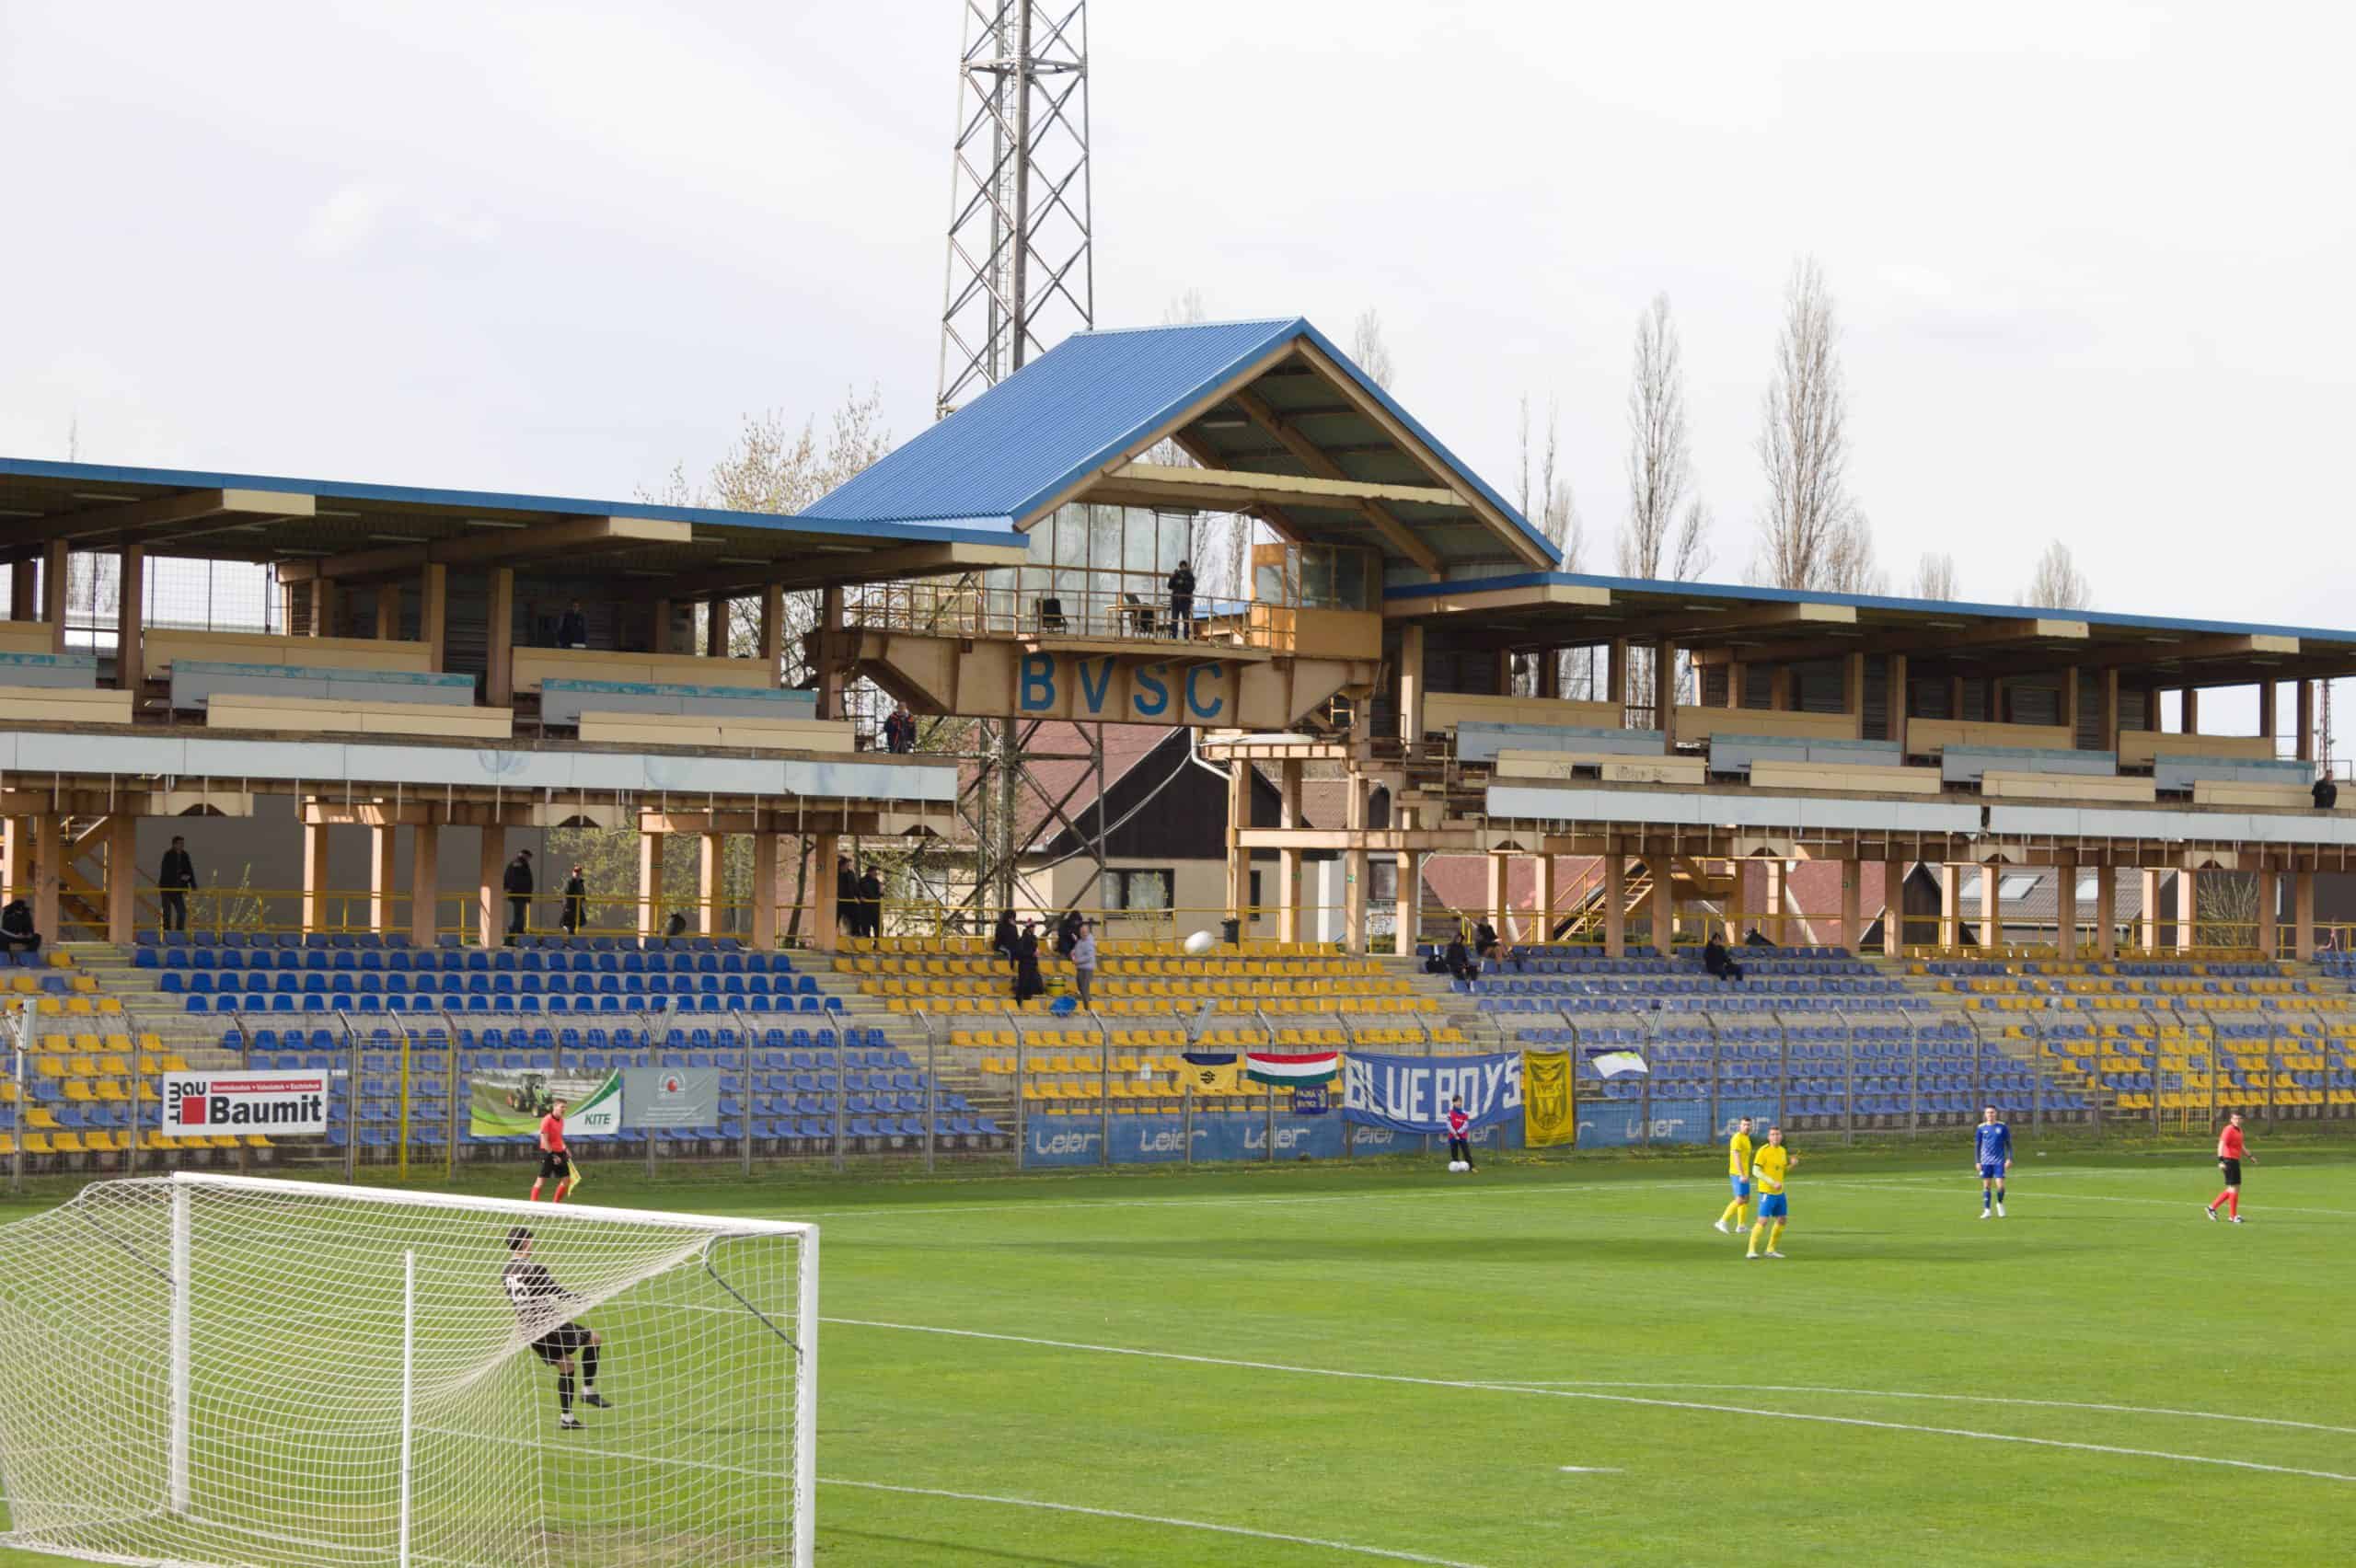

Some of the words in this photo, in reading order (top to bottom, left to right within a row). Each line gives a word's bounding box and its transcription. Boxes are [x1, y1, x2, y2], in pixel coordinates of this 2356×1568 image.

[1020, 651, 1223, 719] BVSC
[209, 1094, 322, 1124] Baumit
[1345, 1055, 1429, 1122] BLUE
[584, 1113, 611, 1125] KITE
